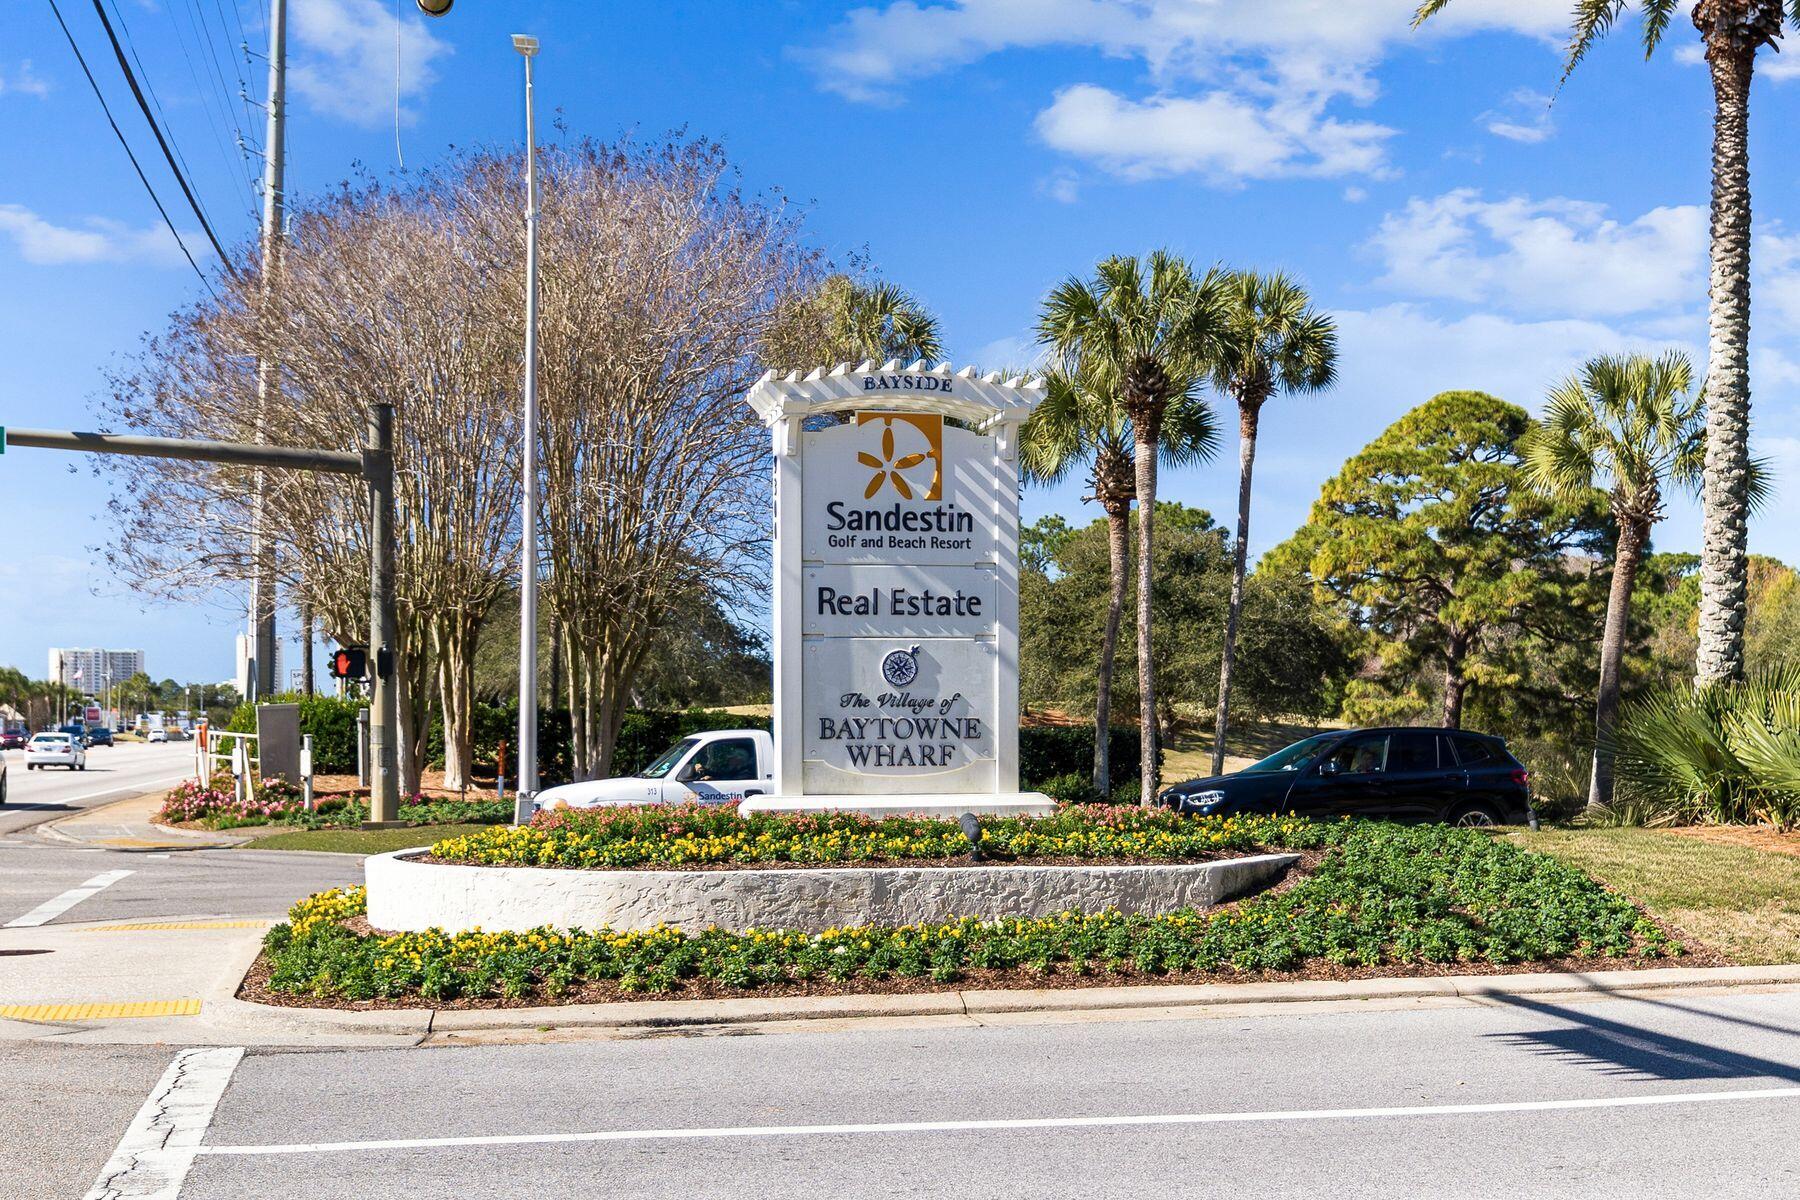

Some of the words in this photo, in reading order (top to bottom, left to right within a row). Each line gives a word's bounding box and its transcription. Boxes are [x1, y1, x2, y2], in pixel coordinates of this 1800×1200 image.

[864, 375, 952, 392] BAYSIDE
[826, 501, 973, 532] Sandestin
[828, 535, 857, 548] Golf
[861, 536, 882, 548] and
[889, 536, 925, 549] Beach
[931, 537, 971, 549] Resort
[817, 587, 878, 616] Real
[891, 588, 981, 616] Estate
[840, 693, 871, 708] The
[877, 693, 934, 715] Village
[941, 693, 961, 715] of
[819, 718, 981, 740] BAYTOWNE
[846, 745, 955, 766] WHARF
[698, 791, 743, 800] Sandestin
